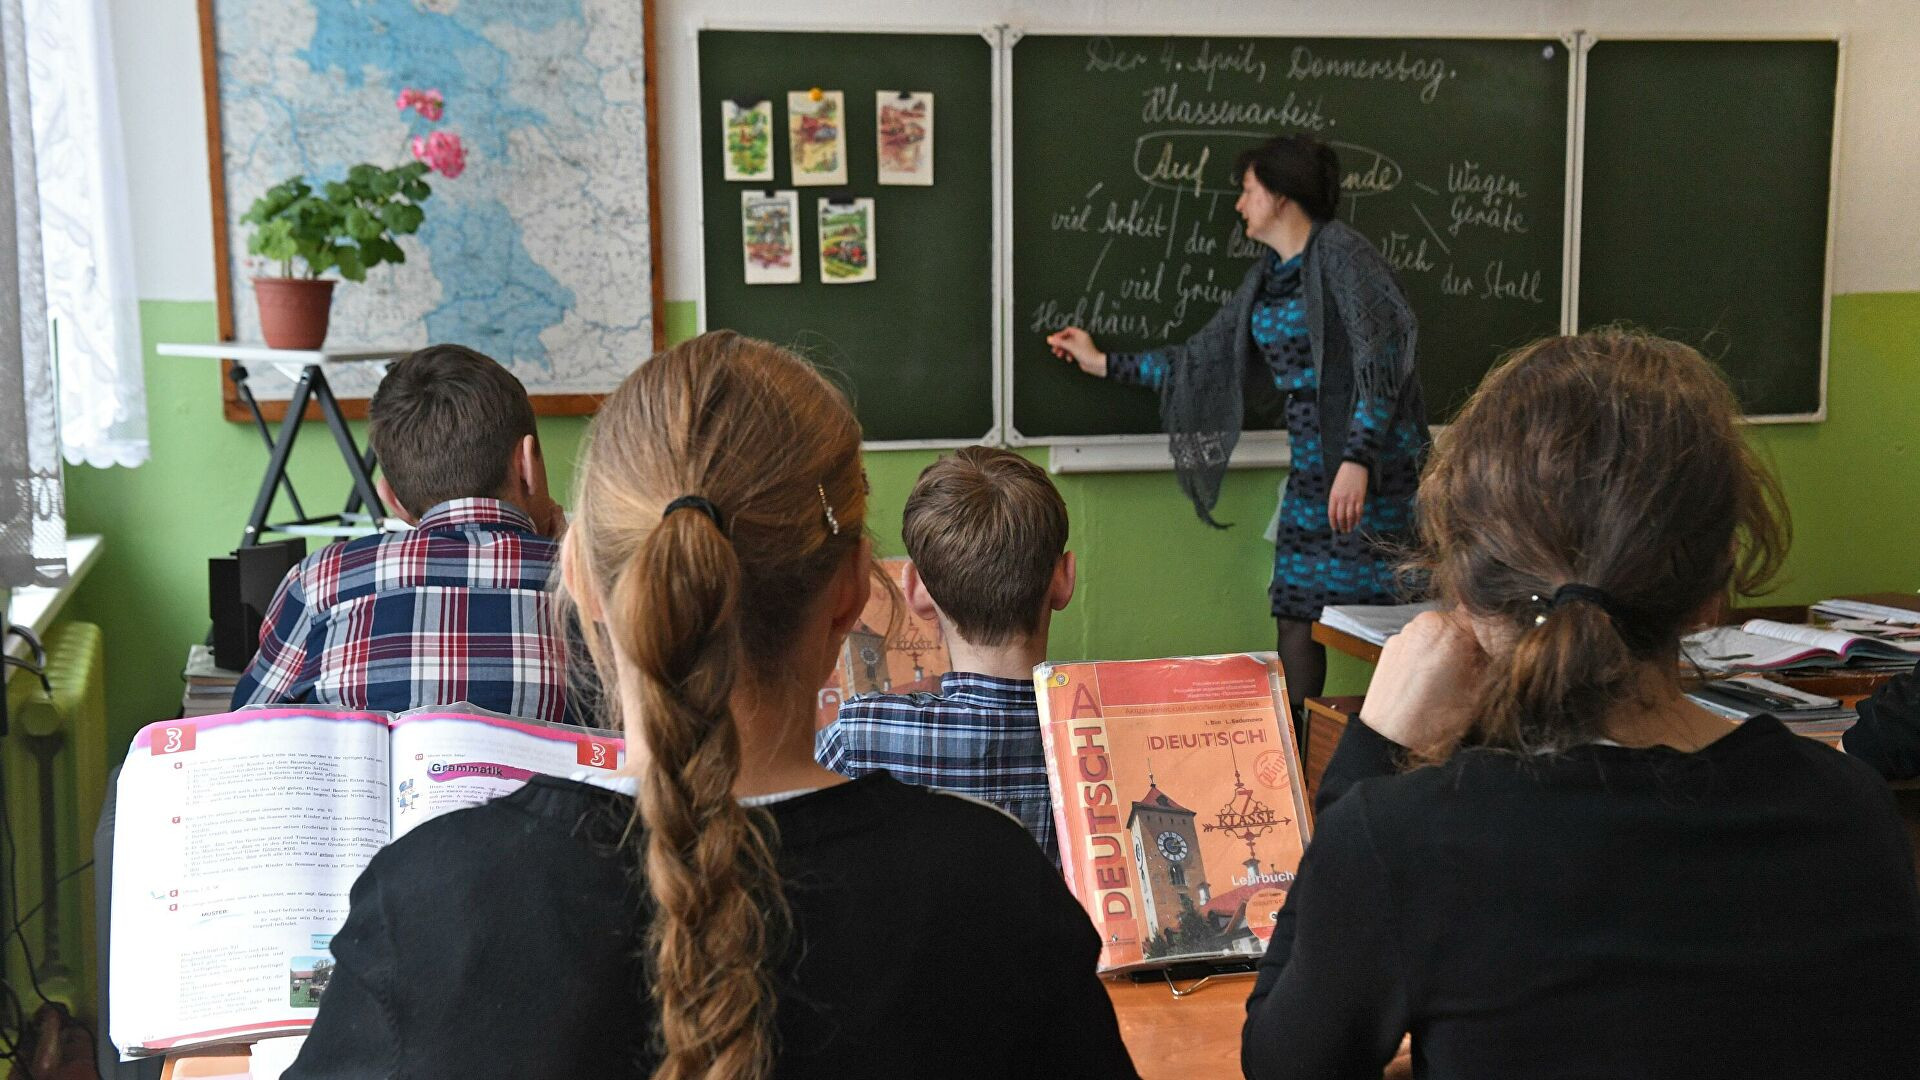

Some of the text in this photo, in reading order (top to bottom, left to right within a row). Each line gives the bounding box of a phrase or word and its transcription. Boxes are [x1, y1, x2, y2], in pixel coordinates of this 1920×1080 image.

[1085, 37, 1457, 104] Der 4. April, Donnerstag.
[1151, 141, 1210, 198] Auf
[1050, 200, 1167, 238] viel Arbeit
[1448, 194, 1529, 238] Geräte
[1184, 221, 1217, 256] der
[1120, 261, 1166, 304] viel
[1440, 260, 1543, 303] der Stall
[163, 727, 183, 754] 3
[589, 742, 607, 768] 3
[1149, 729, 1265, 751] DEUTSCH
[431, 763, 504, 777] Grammatik
[1217, 811, 1276, 828] KLASSE
[1237, 789, 1254, 815] 7
[1073, 726, 1133, 923] DEUTSCH
[1231, 870, 1295, 887] Lehrbuch
